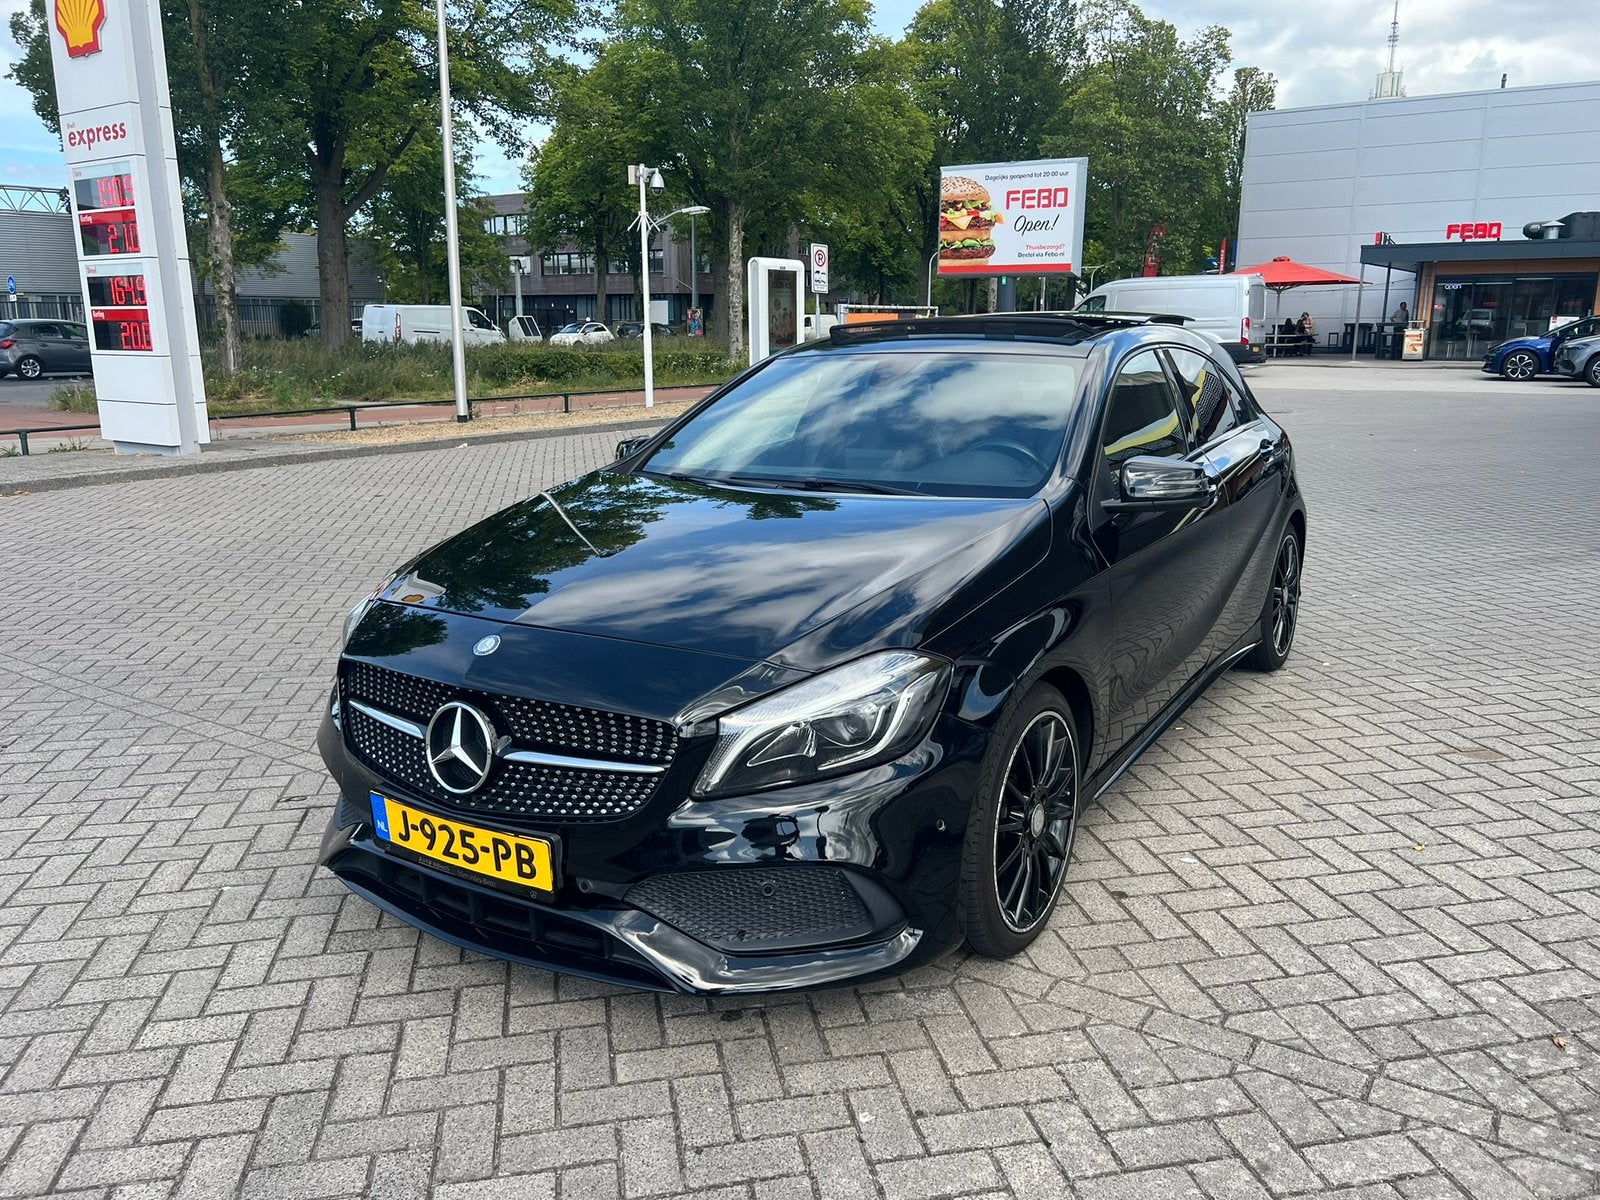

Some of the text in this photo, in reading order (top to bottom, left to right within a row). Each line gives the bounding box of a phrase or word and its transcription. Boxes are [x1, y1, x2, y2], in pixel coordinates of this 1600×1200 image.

[68, 122, 127, 151] express
[1010, 172, 1034, 180] geopend
[1006, 187, 1069, 210] FEBO
[1014, 214, 1060, 236] Open!
[1446, 222, 1502, 240] FEBO
[1026, 243, 1066, 251] Thuisbezorgd?
[109, 276, 147, 305] 164.9
[377, 820, 388, 832] NL
[398, 810, 537, 880] J-925-PB
